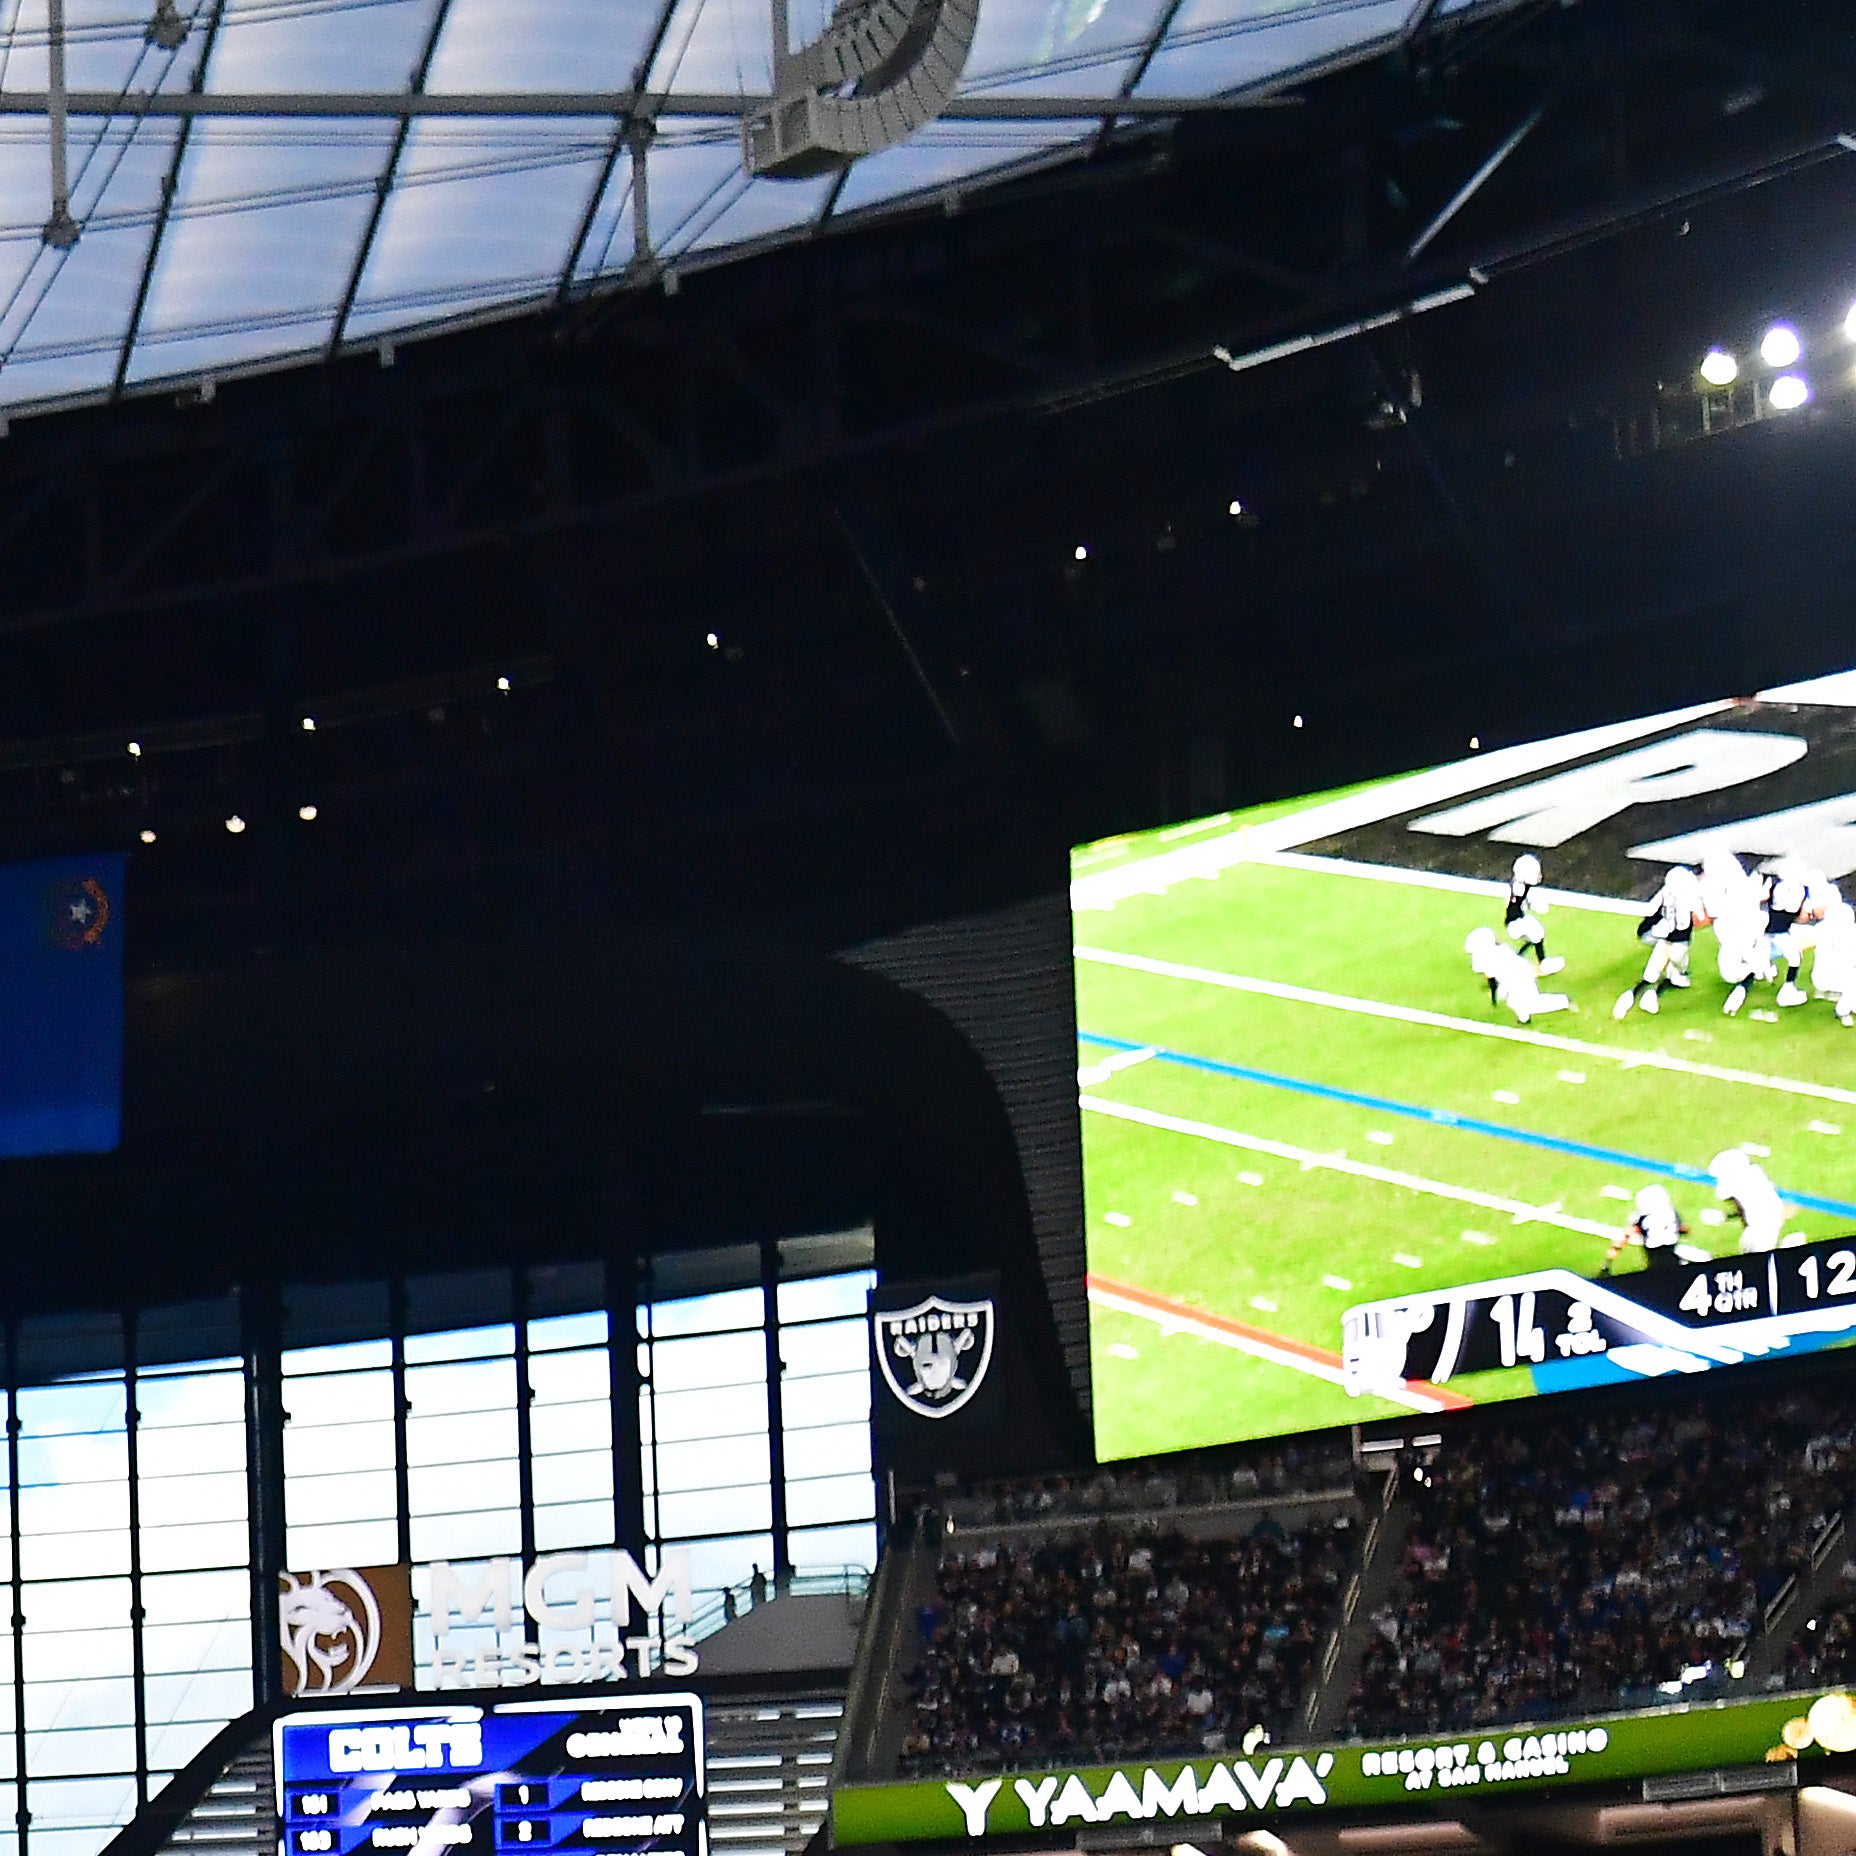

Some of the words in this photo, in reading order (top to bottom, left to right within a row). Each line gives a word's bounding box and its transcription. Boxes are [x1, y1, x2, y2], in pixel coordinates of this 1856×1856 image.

[889, 1313, 979, 1337] RAIDERS
[429, 1549, 692, 1636] MGM
[433, 1636, 700, 1688] RESORTS
[329, 1723, 483, 1773] COLTS
